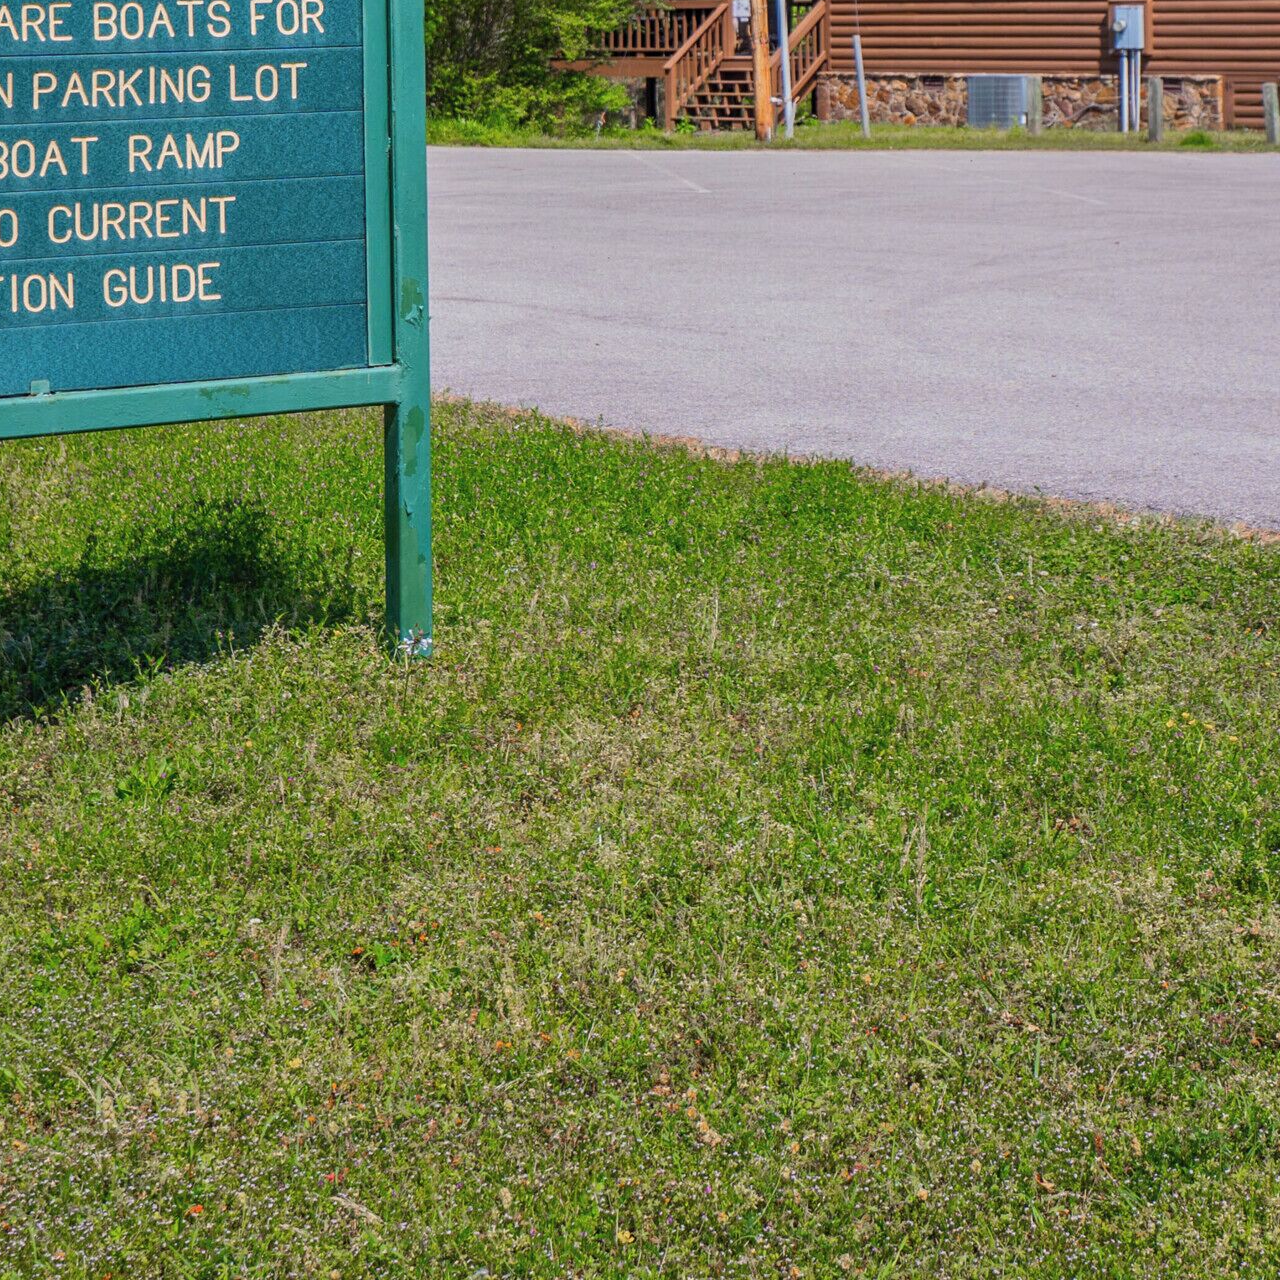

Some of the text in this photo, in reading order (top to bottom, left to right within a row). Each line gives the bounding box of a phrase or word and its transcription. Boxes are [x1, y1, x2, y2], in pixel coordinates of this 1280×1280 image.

[93, 0, 232, 42] BOATS
[32, 63, 212, 111] PARKING
[229, 61, 308, 102] LOT
[128, 130, 241, 174] RAMP
[48, 195, 237, 244] CURRENT
[103, 261, 222, 308] GUIDE
